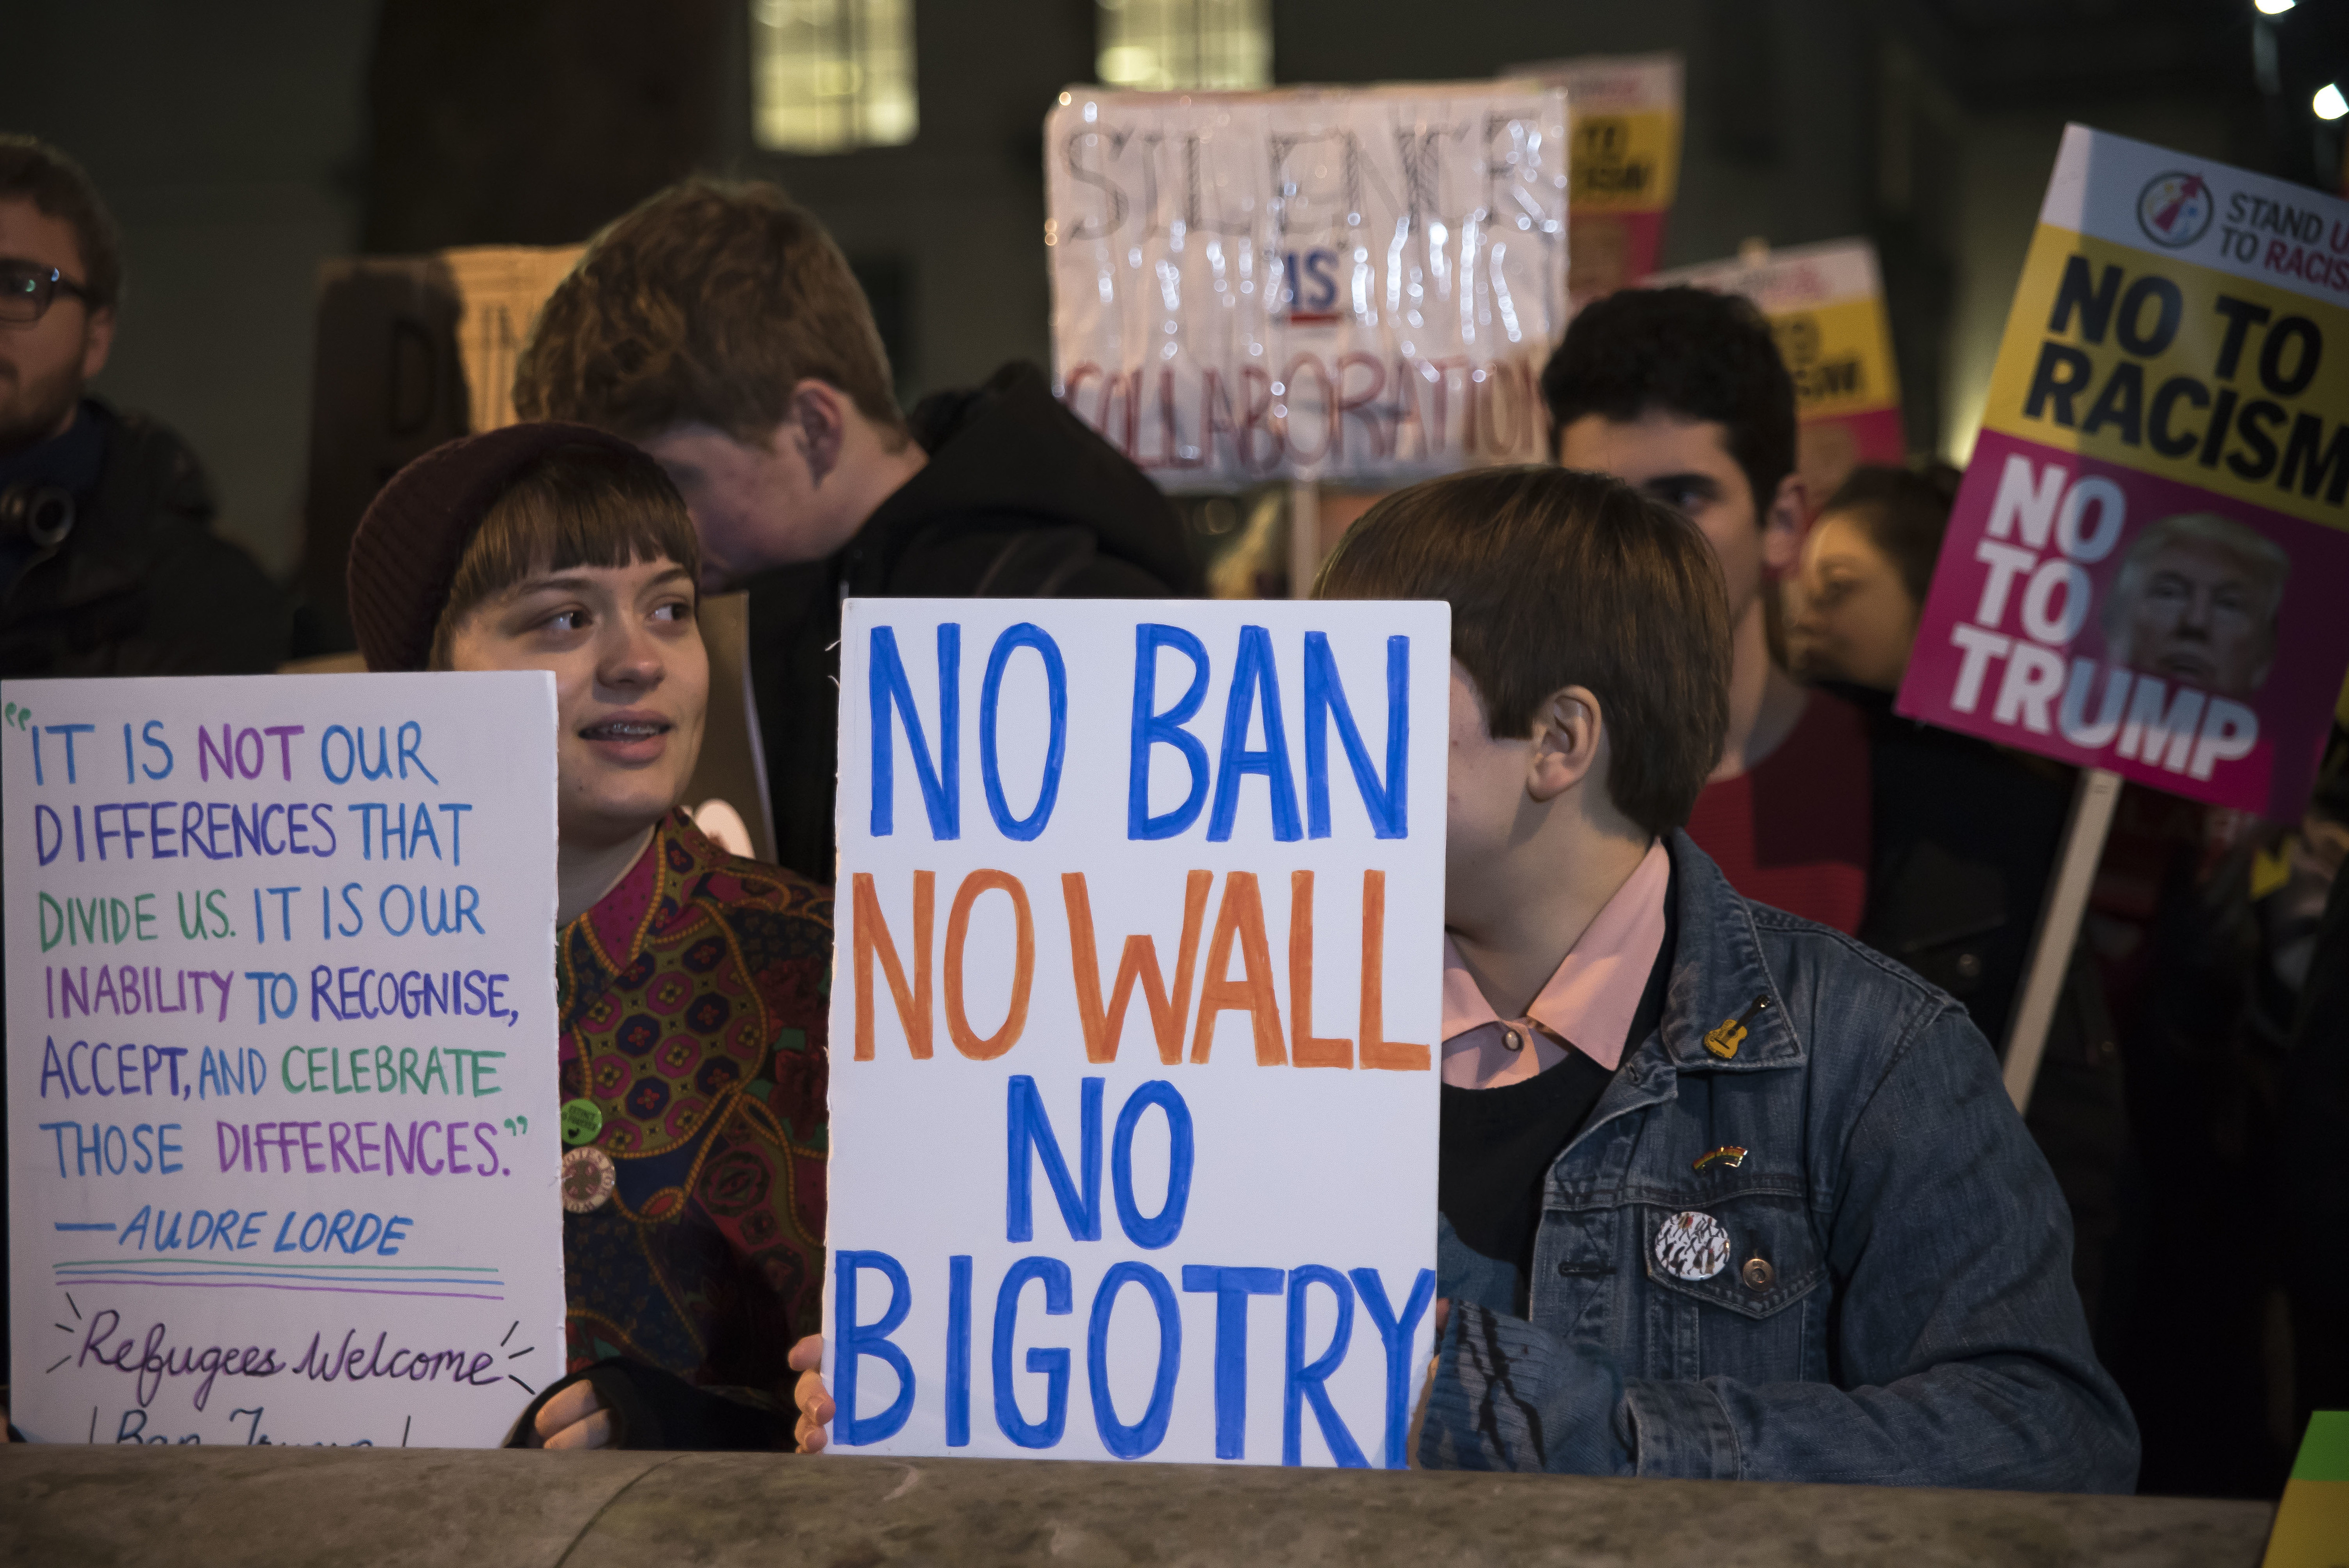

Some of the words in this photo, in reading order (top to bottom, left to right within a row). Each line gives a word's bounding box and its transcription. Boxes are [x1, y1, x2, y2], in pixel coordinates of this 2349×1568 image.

[2221, 224, 2258, 263] TO
[2264, 239, 2349, 292] RACIS
[2228, 192, 2323, 244] STAND
[1285, 247, 1340, 311] IS
[2049, 254, 2184, 358] NO
[2214, 295, 2323, 398] TO
[2023, 341, 2349, 508] RACISM
[1986, 454, 2127, 564] NO
[1976, 536, 2092, 647] TO
[869, 622, 1068, 842] NO
[1127, 623, 1410, 842] BAN
[1950, 622, 2259, 782] TRUMP
[124, 720, 173, 784] IS
[200, 724, 304, 782] NOT
[321, 721, 438, 785] OUR
[34, 801, 335, 867] DIFFERENCES
[348, 802, 473, 866] THAT
[39, 892, 156, 953] DIVIDE
[178, 889, 235, 939] US.
[254, 887, 301, 943] IT
[323, 883, 363, 939] IS
[380, 884, 485, 937] OUR
[46, 965, 233, 1021] INABILITY
[245, 972, 297, 1024] TO
[311, 965, 518, 1026] RECOGNISE,
[852, 869, 1035, 1062] NO
[1061, 869, 1431, 1071] WALL
[199, 1046, 266, 1099] AND
[282, 1045, 506, 1097] CELEBRATE
[39, 1121, 182, 1178] THOSE
[1006, 1074, 1194, 1250] NO
[274, 1210, 413, 1256] LORDE
[78, 1309, 285, 1411] Refugees
[292, 1329, 504, 1385] Welcome
[832, 1250, 1436, 1469] BIGOTRY
